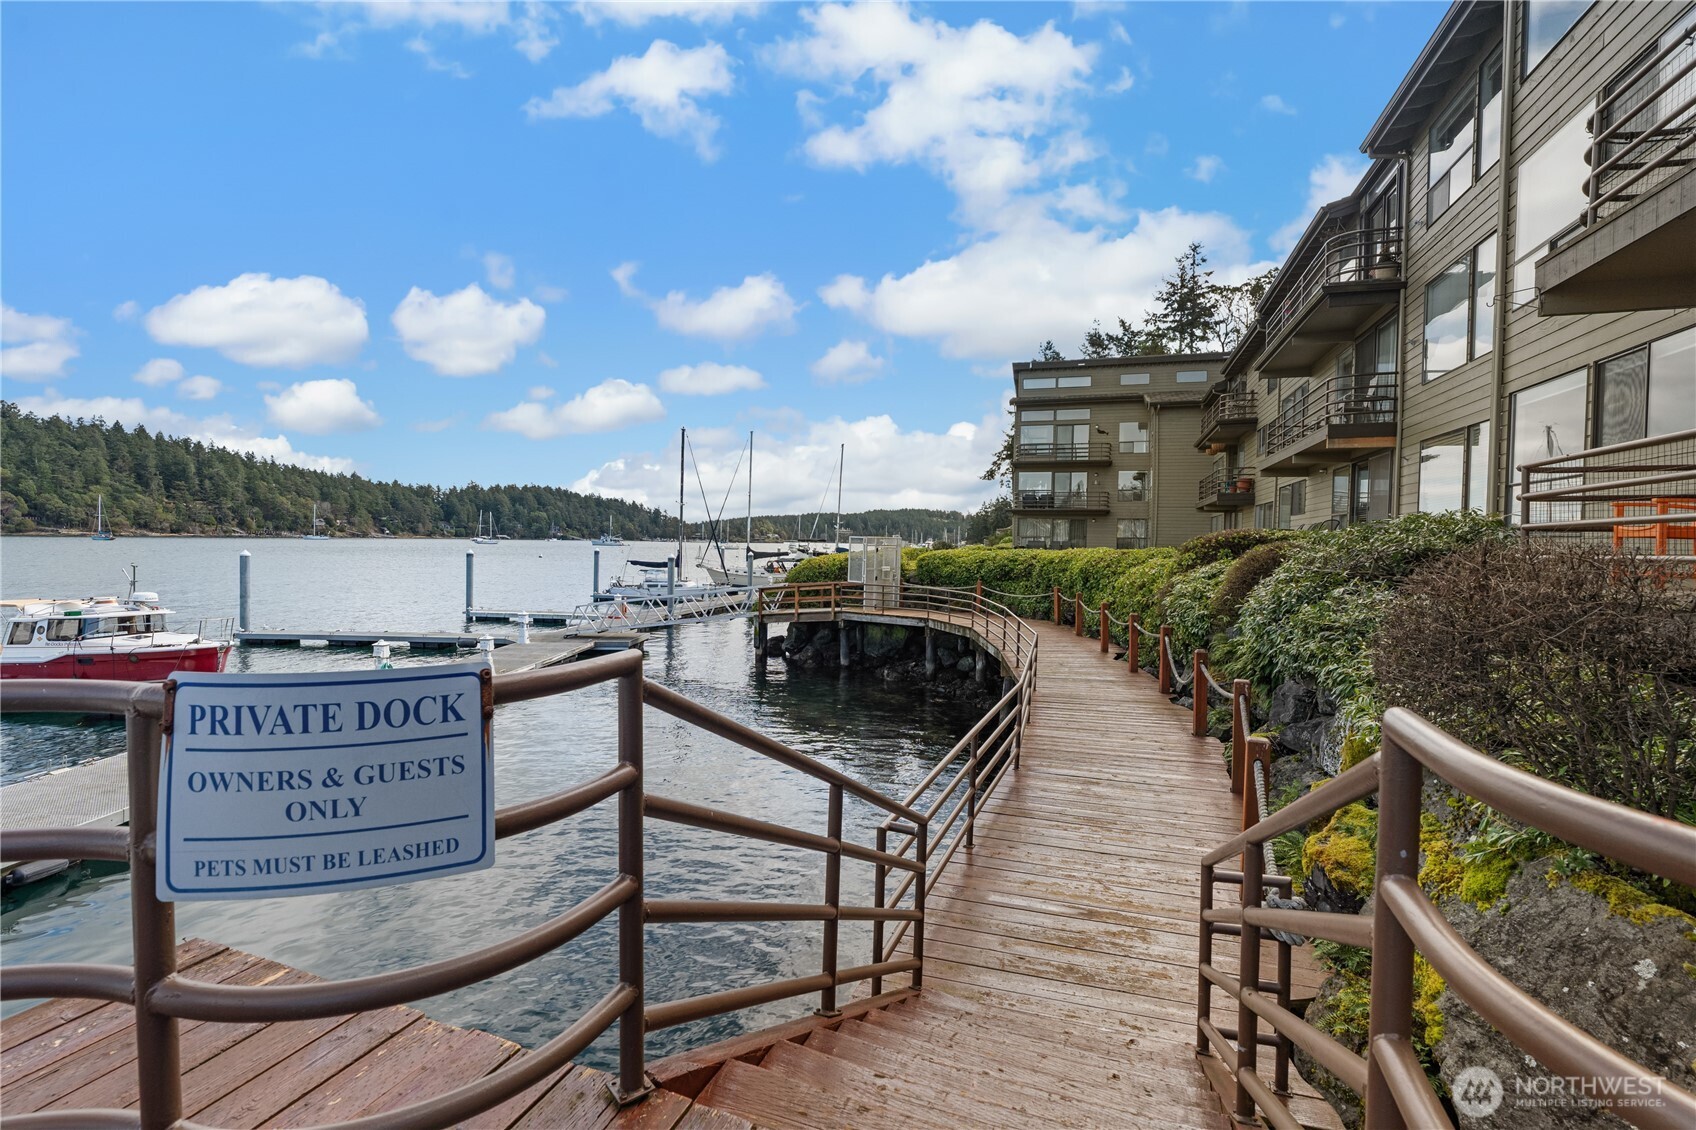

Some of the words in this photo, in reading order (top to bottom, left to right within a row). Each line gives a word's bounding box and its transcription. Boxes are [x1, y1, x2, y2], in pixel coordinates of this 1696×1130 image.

[187, 702, 343, 736] PRIVATE
[355, 692, 466, 731] DOCK
[187, 768, 313, 793] OWNERS
[321, 767, 345, 789] &
[353, 754, 466, 786] GUESTS
[285, 796, 368, 823] ONLY
[194, 859, 247, 878] PETS
[252, 854, 316, 877] MUST
[322, 851, 351, 871] BE
[358, 837, 460, 867] LEASHED
